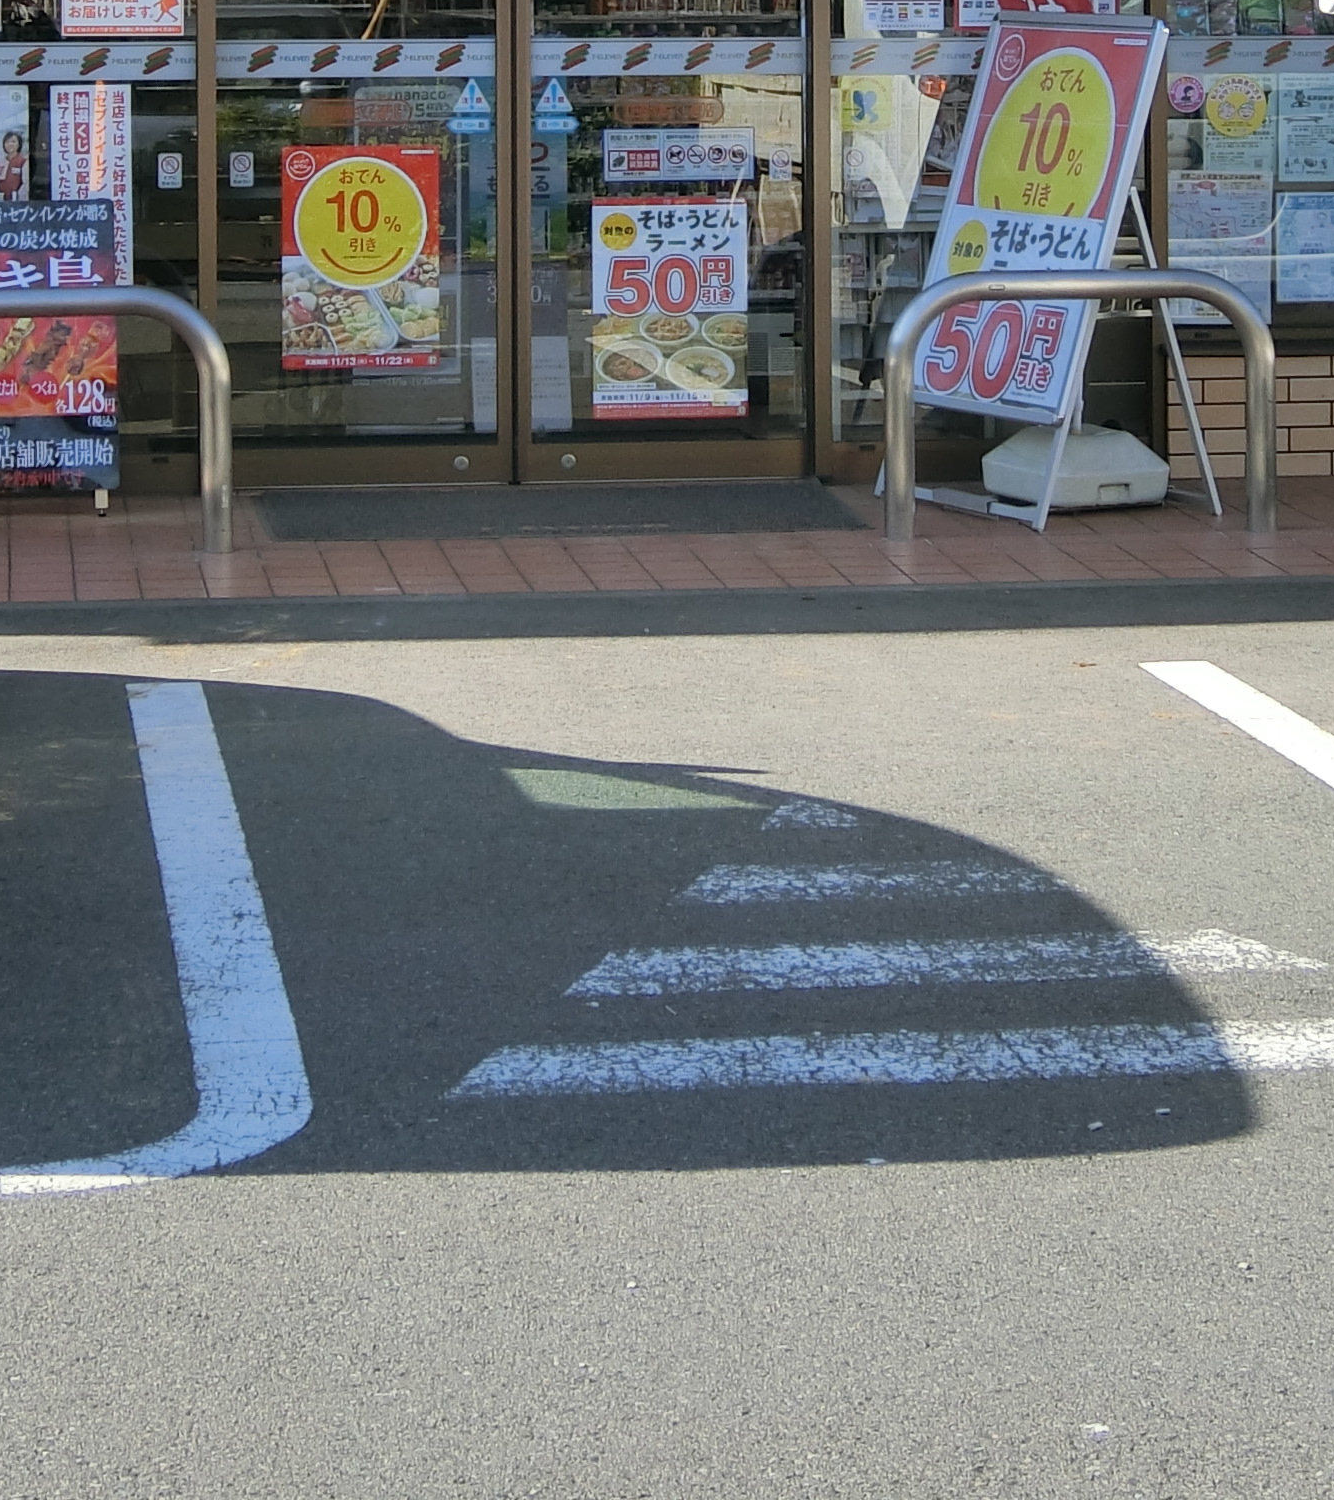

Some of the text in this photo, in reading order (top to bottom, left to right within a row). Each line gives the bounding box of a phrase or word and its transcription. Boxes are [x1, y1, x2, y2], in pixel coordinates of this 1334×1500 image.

[1040, 67, 1085, 92] おでん
[338, 168, 386, 185] おでん
[1021, 182, 1052, 207] 引き
[637, 208, 739, 228] そば・うどん
[349, 237, 377, 253] 引き
[646, 233, 731, 252] ラーメン
[952, 240, 984, 258] 対象の
[990, 219, 1091, 260] そば・うどん
[700, 287, 732, 305] 引き
[1016, 359, 1055, 391] 引き
[31, 381, 57, 396] つくね
